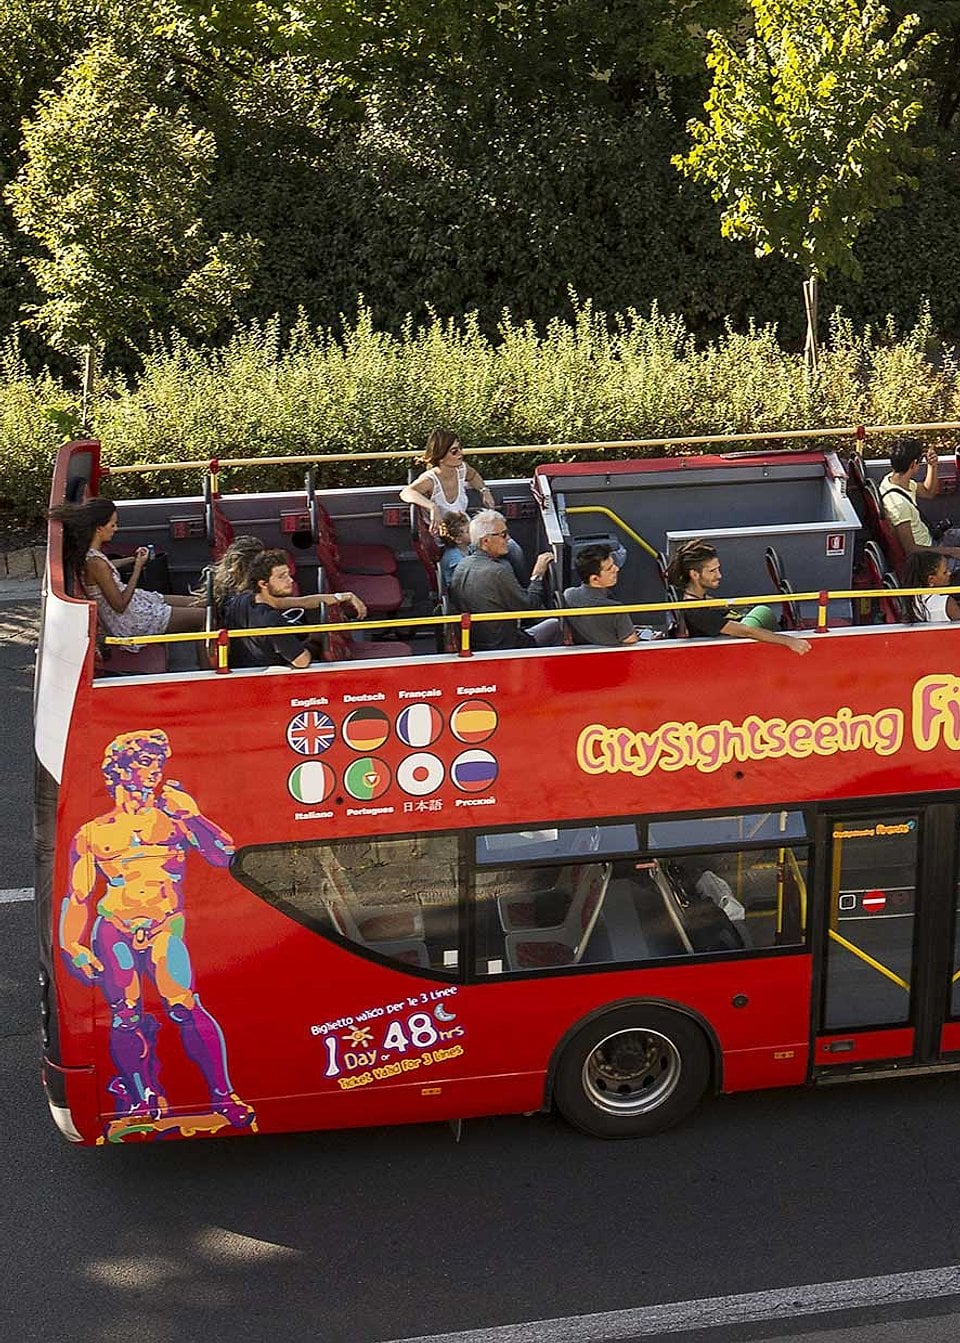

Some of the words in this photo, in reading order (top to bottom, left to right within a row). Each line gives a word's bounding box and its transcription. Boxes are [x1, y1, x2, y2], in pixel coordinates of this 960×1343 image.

[398, 689, 443, 700] Français
[456, 685, 497, 696] Español
[290, 697, 329, 708] English
[343, 692, 385, 703] Deutsch
[403, 799, 444, 813] 日本語
[294, 811, 334, 821] Italiano
[420, 993, 429, 1003] 3
[344, 1050, 377, 1070] Day
[383, 1012, 438, 1052] 48
[438, 1026, 464, 1040] hrs
[421, 1053, 433, 1065] 3
